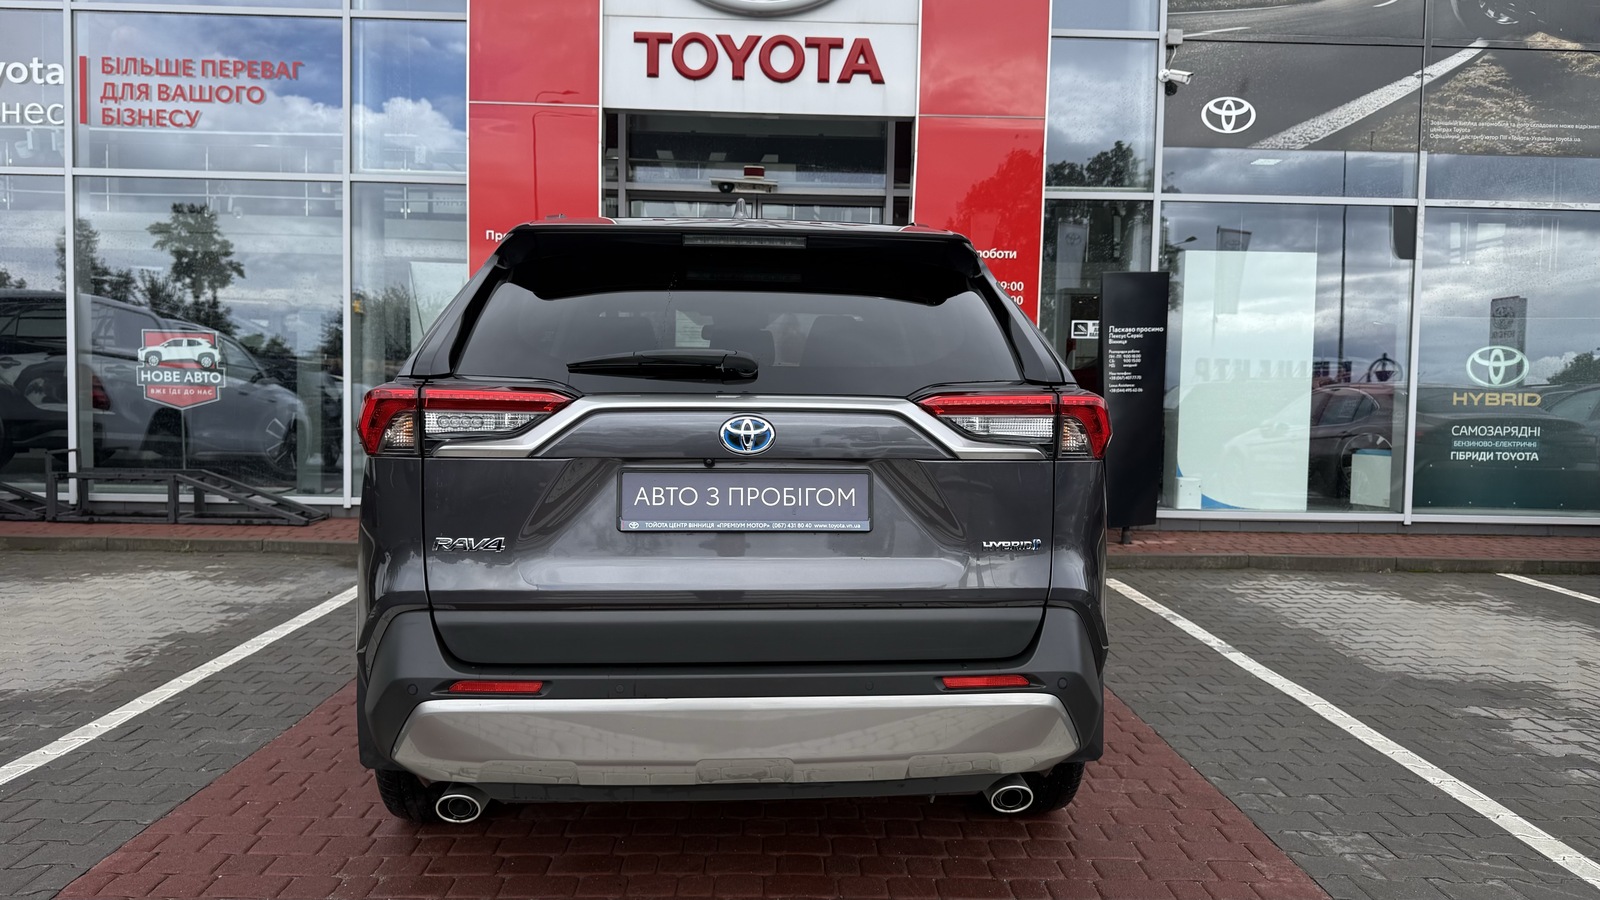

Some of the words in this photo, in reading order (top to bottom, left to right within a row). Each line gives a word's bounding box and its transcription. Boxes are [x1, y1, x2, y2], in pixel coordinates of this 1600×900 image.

[634, 31, 885, 84] TOYOTA
[101, 57, 195, 77] БІЛЬШЕ
[201, 60, 303, 79] ПЕРЕВАГ
[100, 82, 150, 103] ДЛЯ
[157, 84, 265, 104] ВАШОГО
[101, 108, 200, 127] БІЗНЕСУ
[141, 370, 180, 382] НОВЕ
[184, 372, 221, 383] АВТО
[1453, 392, 1541, 406] HYBRID
[1452, 426, 1541, 438] САМОЗАРЯДНІ
[1451, 452, 1494, 462] ГІБРИДИ
[1496, 452, 1539, 461] TOYOTA
[634, 487, 698, 506] АВТО
[706, 487, 720, 506] З
[729, 487, 856, 507] ПРОБІГОМ
[432, 537, 506, 552] RAV4
[982, 540, 1033, 551] HYBRID
